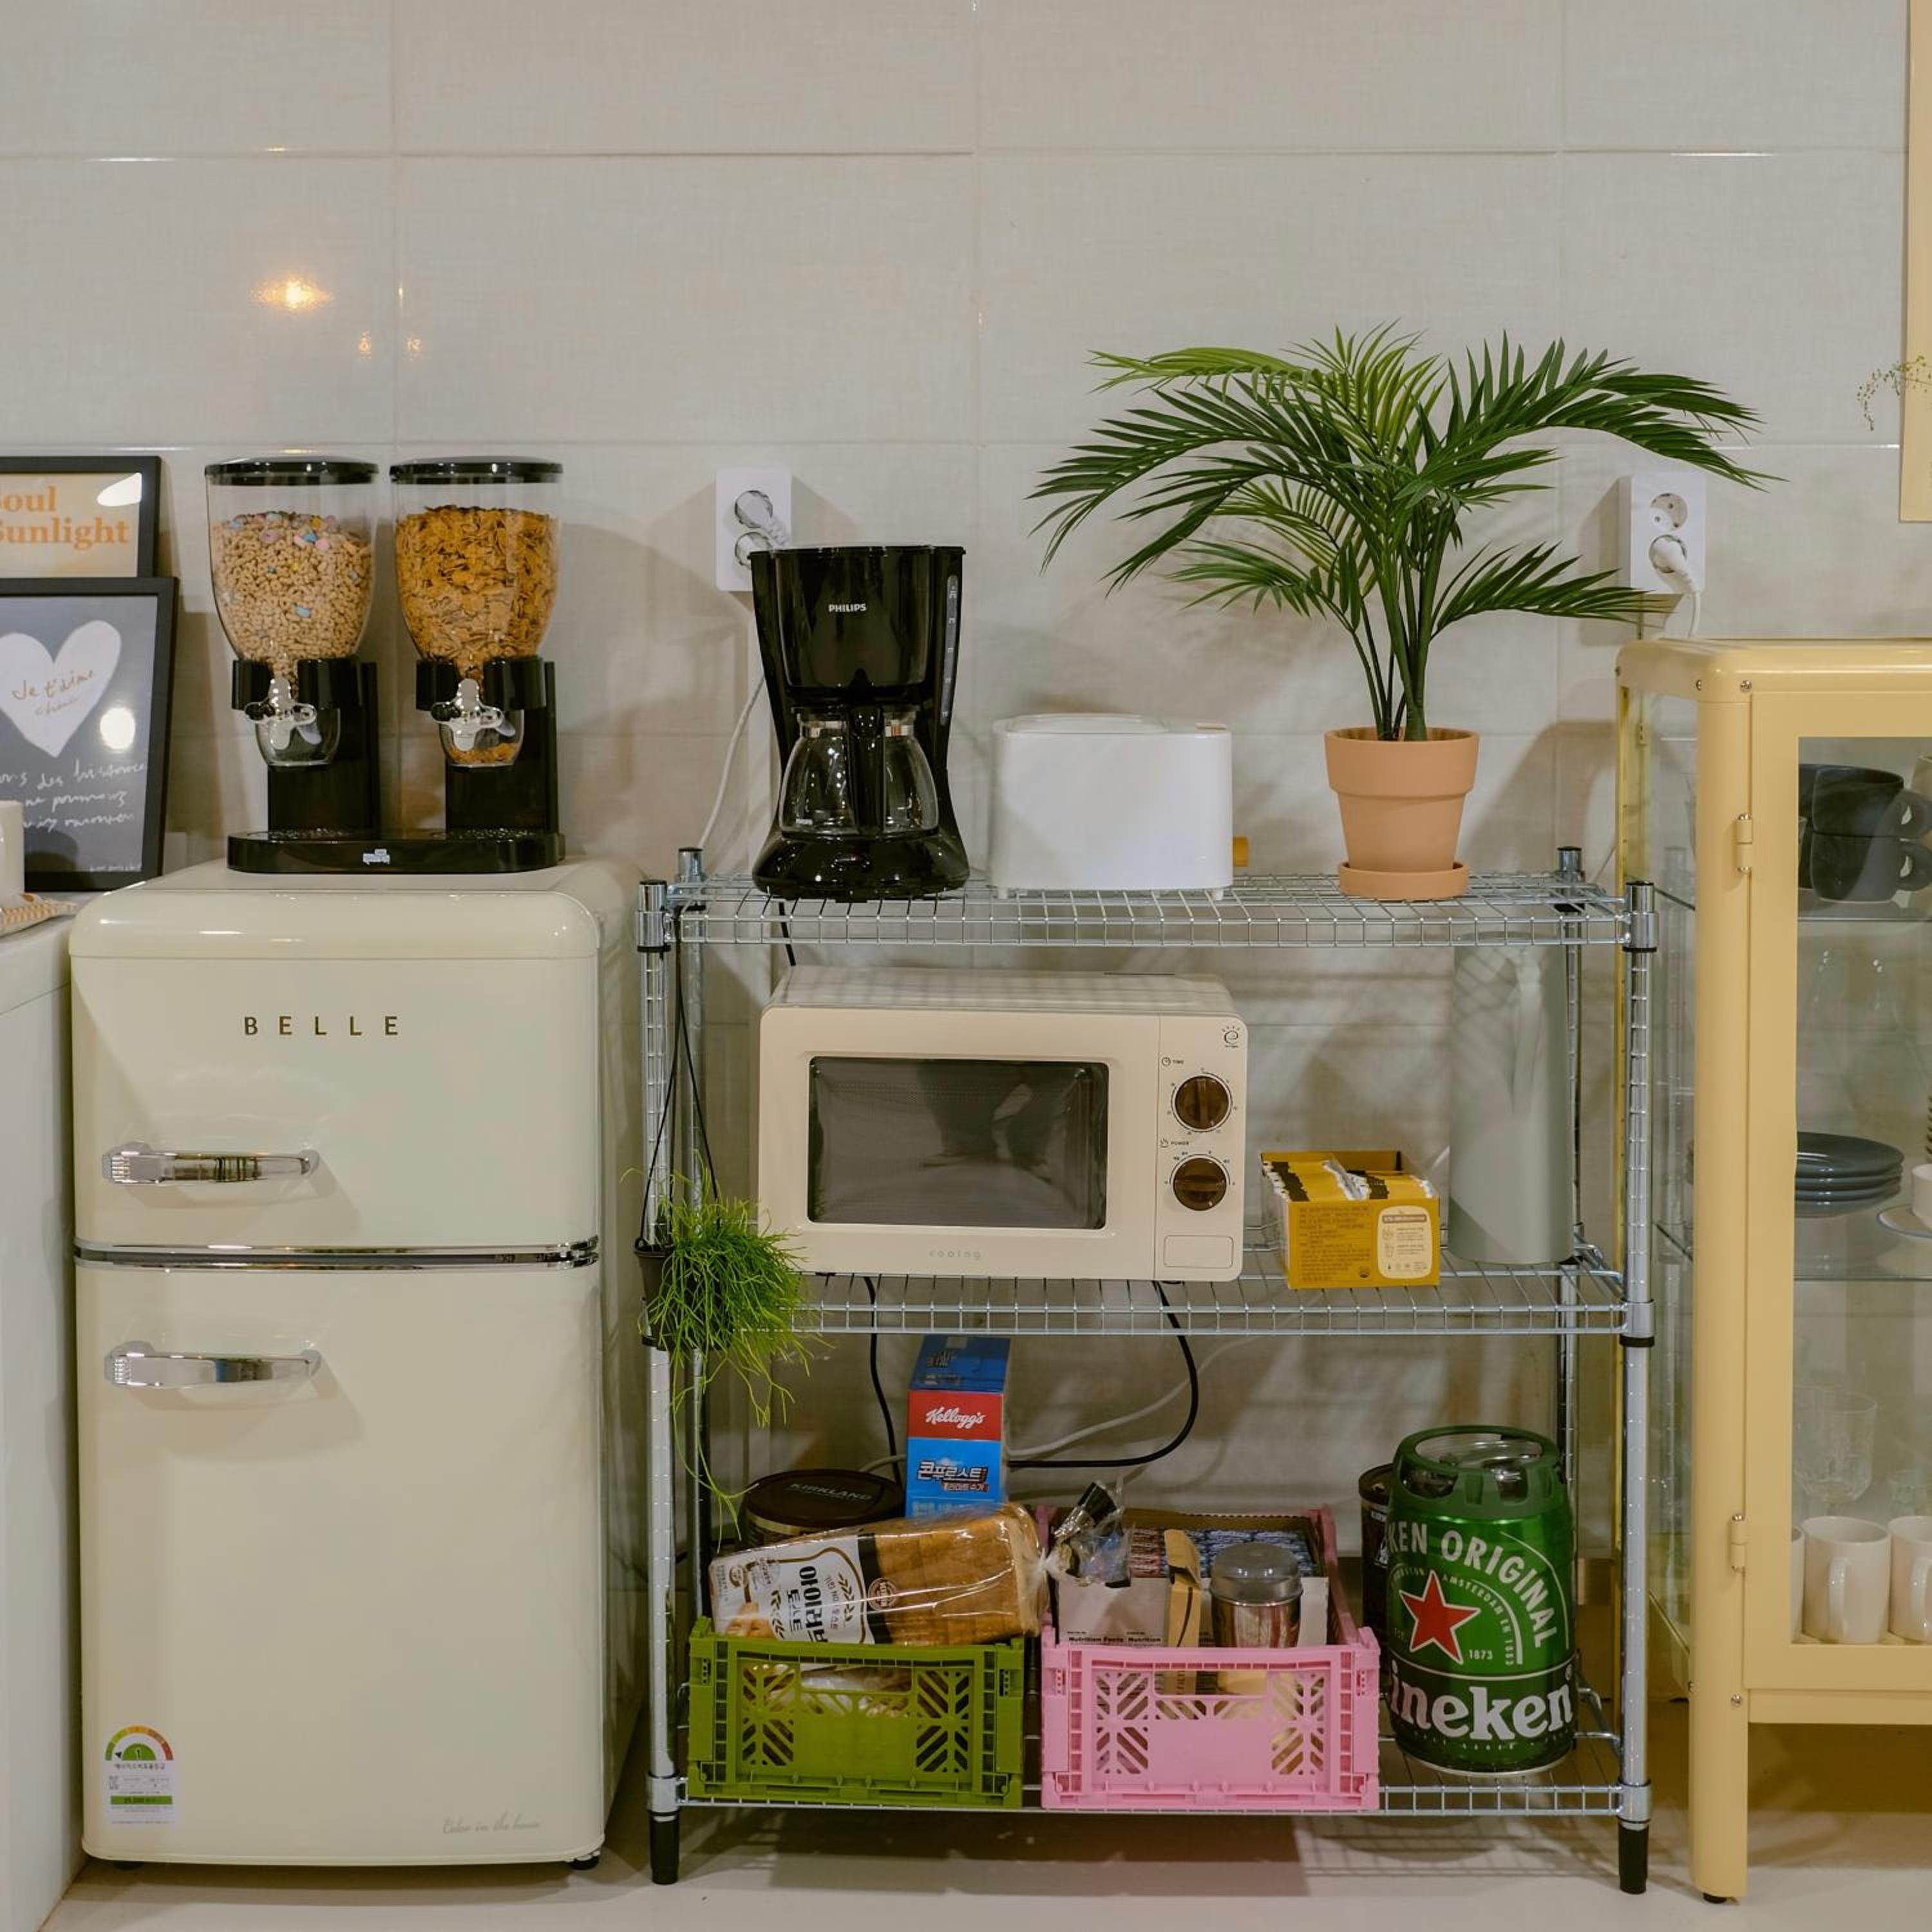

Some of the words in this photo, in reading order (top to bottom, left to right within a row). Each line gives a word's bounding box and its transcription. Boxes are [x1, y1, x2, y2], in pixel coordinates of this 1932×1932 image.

[0, 486, 56, 512] oul
[828, 603, 867, 612] PHILIPS
[244, 1016, 399, 1036] BELLE
[925, 1406, 987, 1430] Kellogg's
[917, 1461, 983, 1482] 콘푸로스트
[790, 1482, 873, 1501] KIRKLAND
[1441, 1530, 1557, 1648] ORIGINAL
[1442, 1573, 1504, 1616] AMSTERDAM
